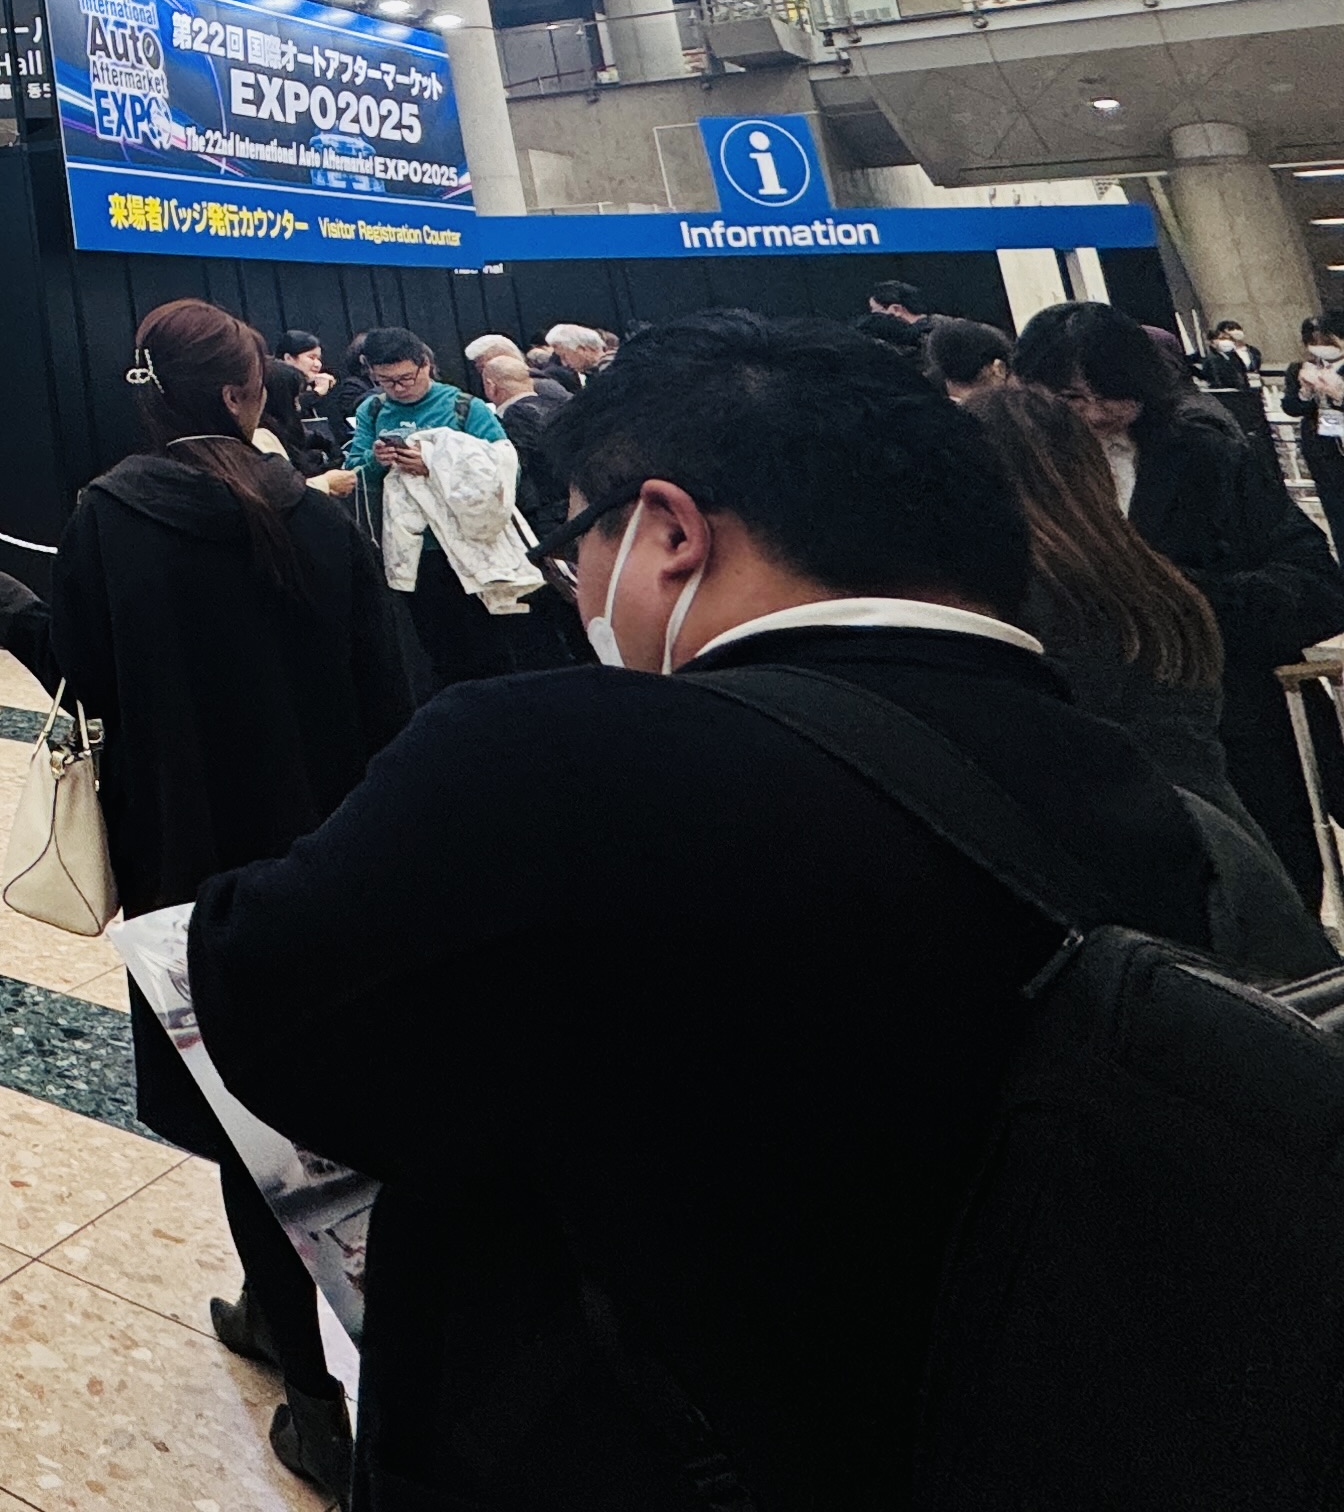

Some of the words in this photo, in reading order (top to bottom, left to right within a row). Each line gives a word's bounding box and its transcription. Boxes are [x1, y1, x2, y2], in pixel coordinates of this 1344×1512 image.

[90, 16, 161, 70] Auto
[172, 12, 244, 61] 第22回
[246, 29, 444, 100] 国際オートアフターマーケット
[92, 63, 168, 96] Aftermarket
[94, 89, 172, 144] EXPO
[230, 68, 423, 144] EXPO2025
[235, 134, 297, 166] International
[298, 144, 321, 168] Auto
[323, 147, 374, 174] Aftermarket
[108, 192, 309, 240] 来場者バッジ発行カウンター
[318, 217, 356, 240] Visitor
[358, 221, 421, 245] Registration
[423, 225, 462, 246] Counter
[680, 218, 880, 249] Information
